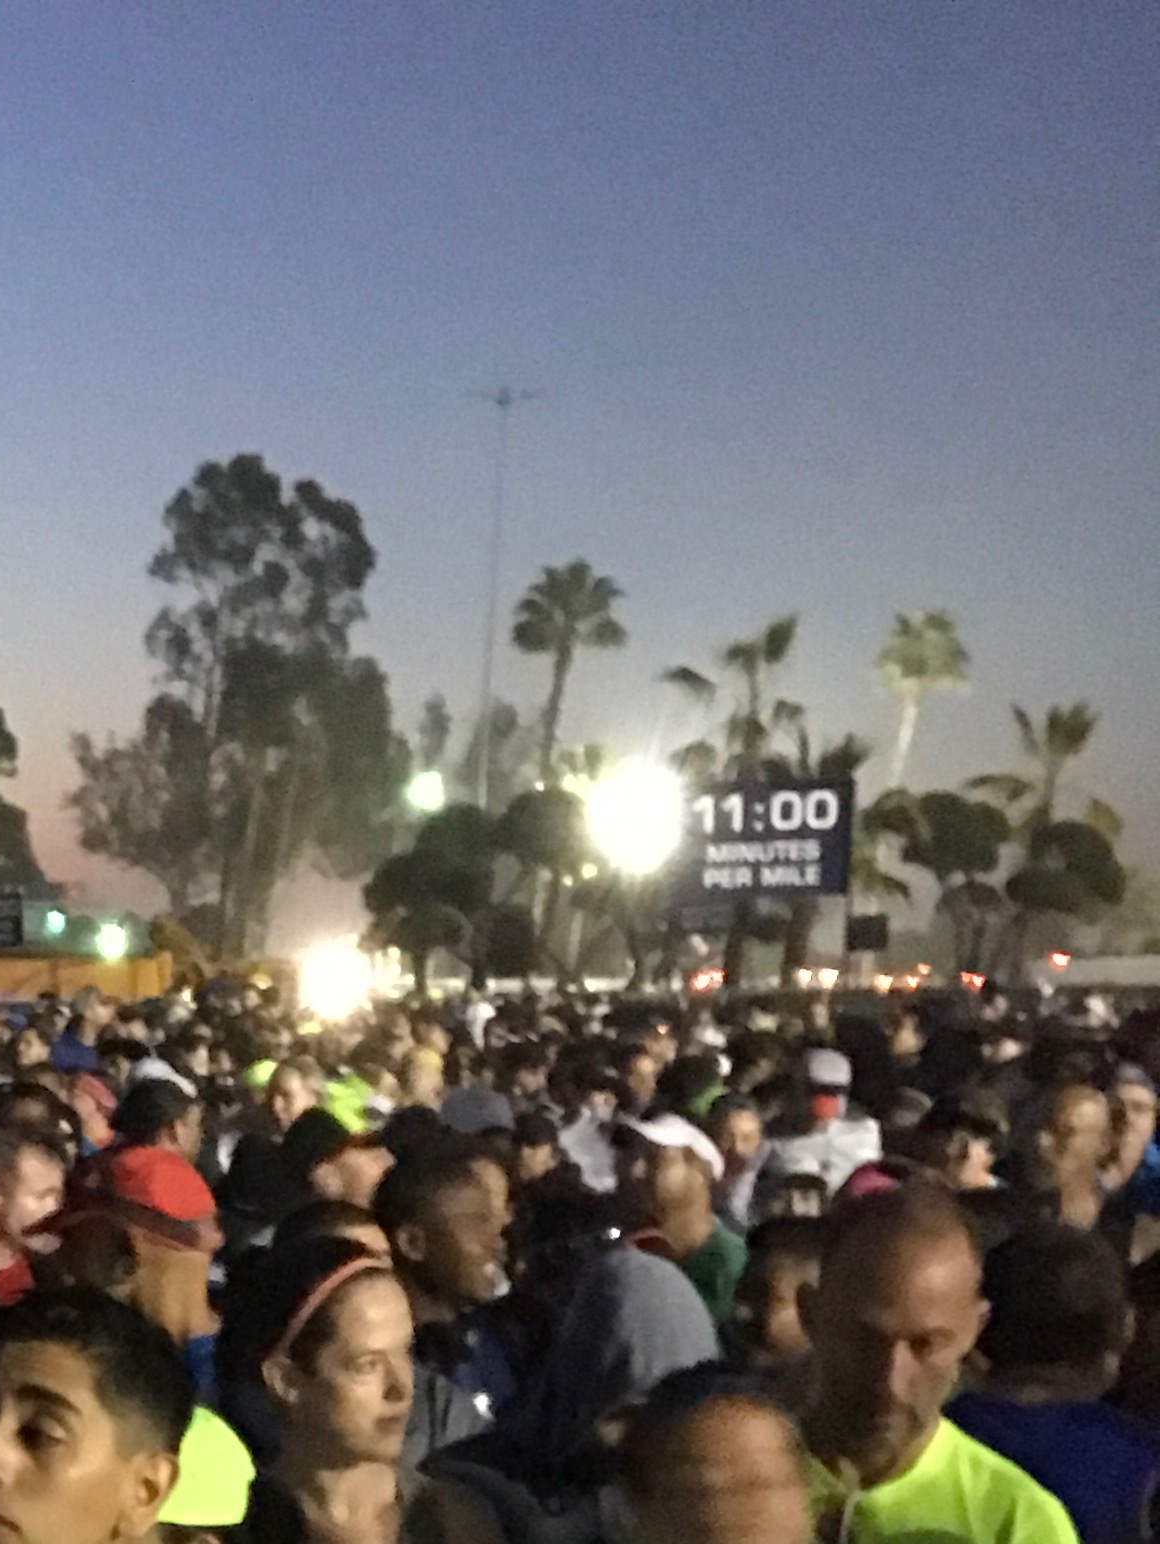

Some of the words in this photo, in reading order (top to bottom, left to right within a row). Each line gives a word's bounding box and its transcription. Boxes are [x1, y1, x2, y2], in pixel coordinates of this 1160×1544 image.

[692, 788, 839, 834] 11:00
[706, 839, 821, 862] MINUTES
[703, 867, 752, 889] PER
[760, 865, 821, 886] MILE
